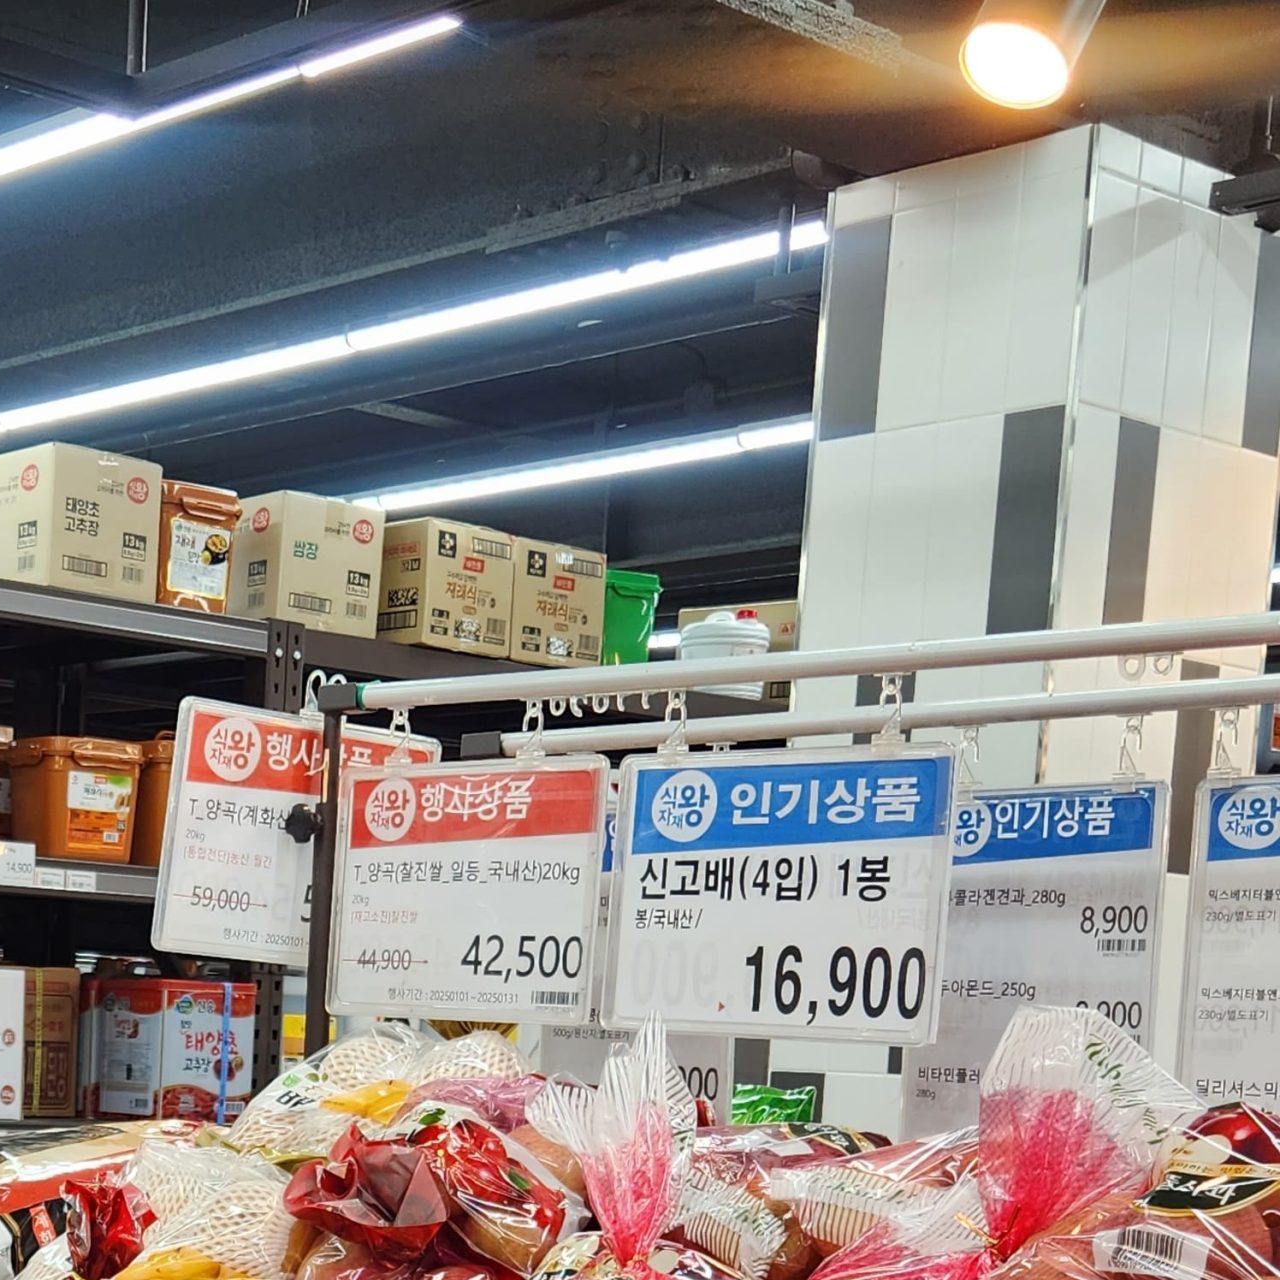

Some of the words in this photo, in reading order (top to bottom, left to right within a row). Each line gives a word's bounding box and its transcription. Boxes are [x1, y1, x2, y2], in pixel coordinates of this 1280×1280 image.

[65, 497, 100, 518] 태양초
[64, 516, 99, 537] 고추장
[293, 540, 318, 560] 쌈장
[421, 780, 531, 822] 행사상품
[729, 777, 921, 826] 인기상품
[995, 796, 1115, 839] 인기상품
[640, 855, 818, 902] 신고배(4입)
[838, 856, 891, 902] 1봉
[190, 886, 250, 912] 59,000
[949, 887, 1066, 907] 콜라겐견과_280g
[1080, 905, 1148, 938] 8,900
[357, 949, 411, 972] 44,900
[461, 935, 583, 983] 42,500
[746, 945, 926, 1026] 16,900
[183, 1057, 210, 1073] 고추장
